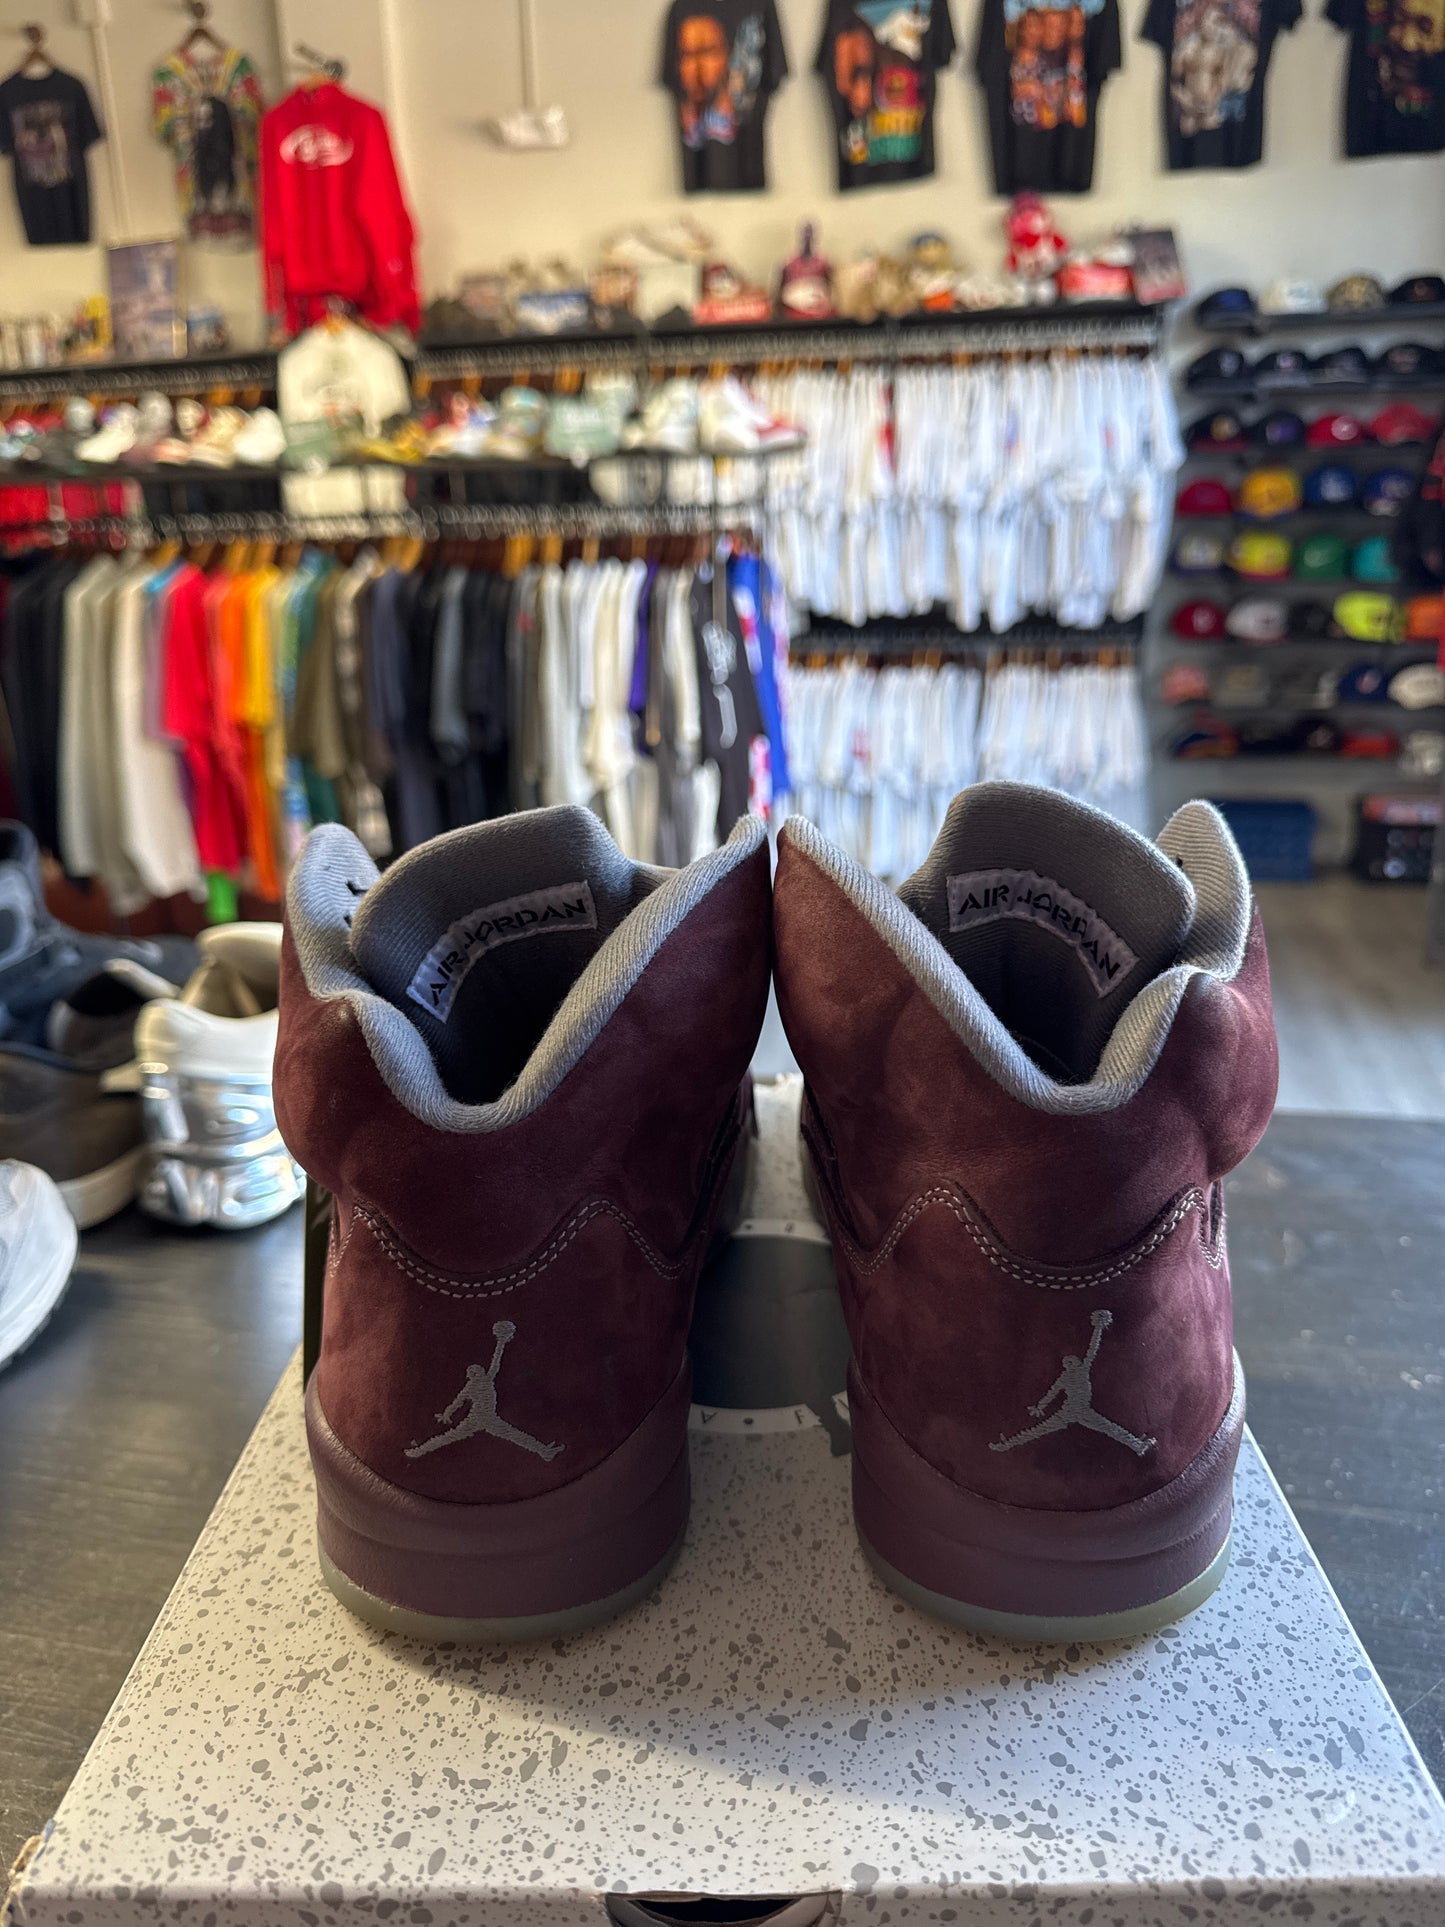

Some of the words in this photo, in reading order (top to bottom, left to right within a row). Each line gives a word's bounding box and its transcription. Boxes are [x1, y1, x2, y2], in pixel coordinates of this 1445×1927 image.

[430, 950, 465, 1006] AIR
[464, 898, 588, 950] JORDAN
[957, 885, 1010, 915] AIR
[1016, 888, 1121, 980] JORDAN
